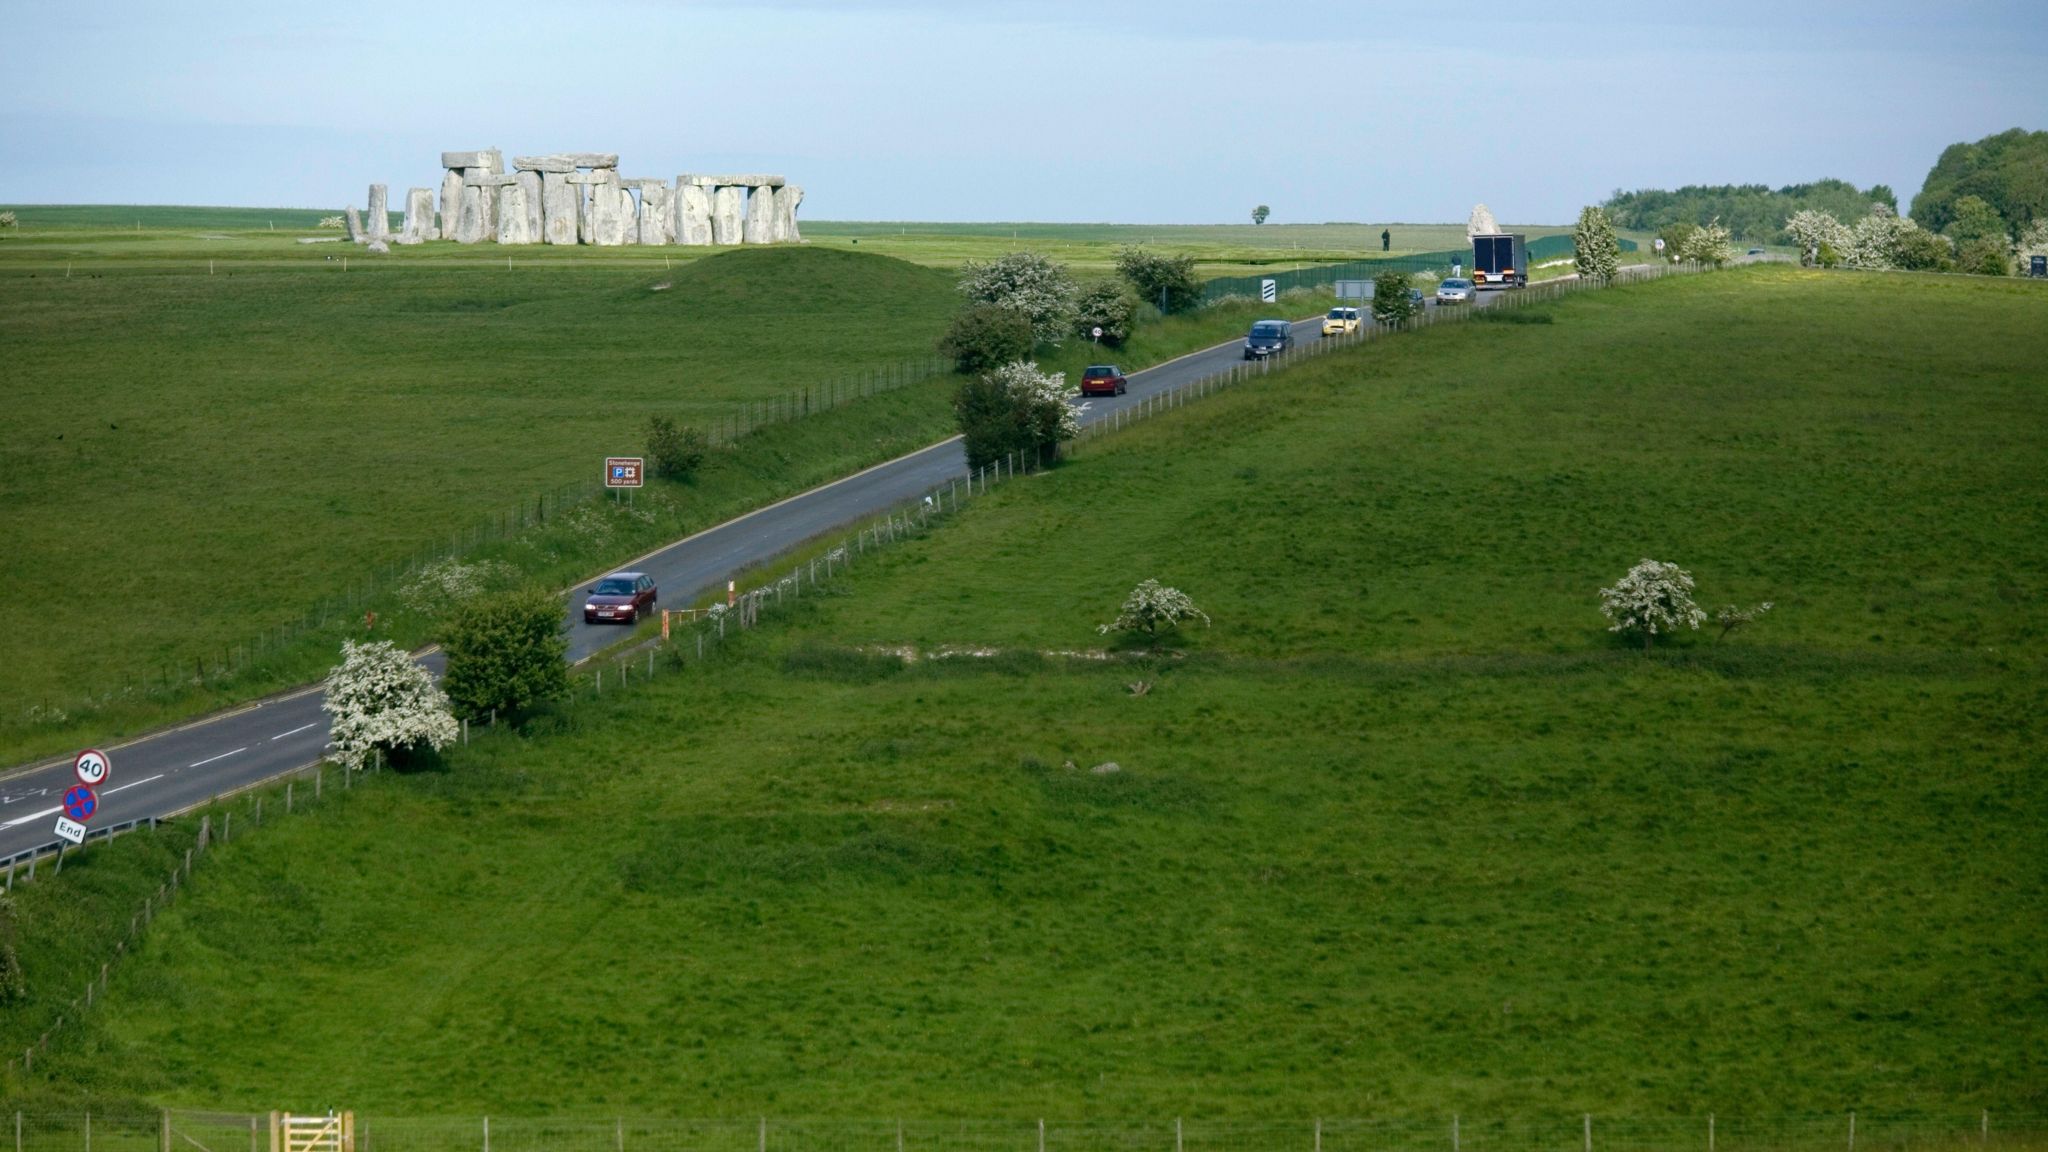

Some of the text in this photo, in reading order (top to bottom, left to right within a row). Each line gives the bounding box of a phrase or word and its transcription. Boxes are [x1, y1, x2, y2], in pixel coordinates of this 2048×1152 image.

[616, 468, 623, 477] P
[79, 759, 103, 778] 40
[59, 821, 82, 838] End
